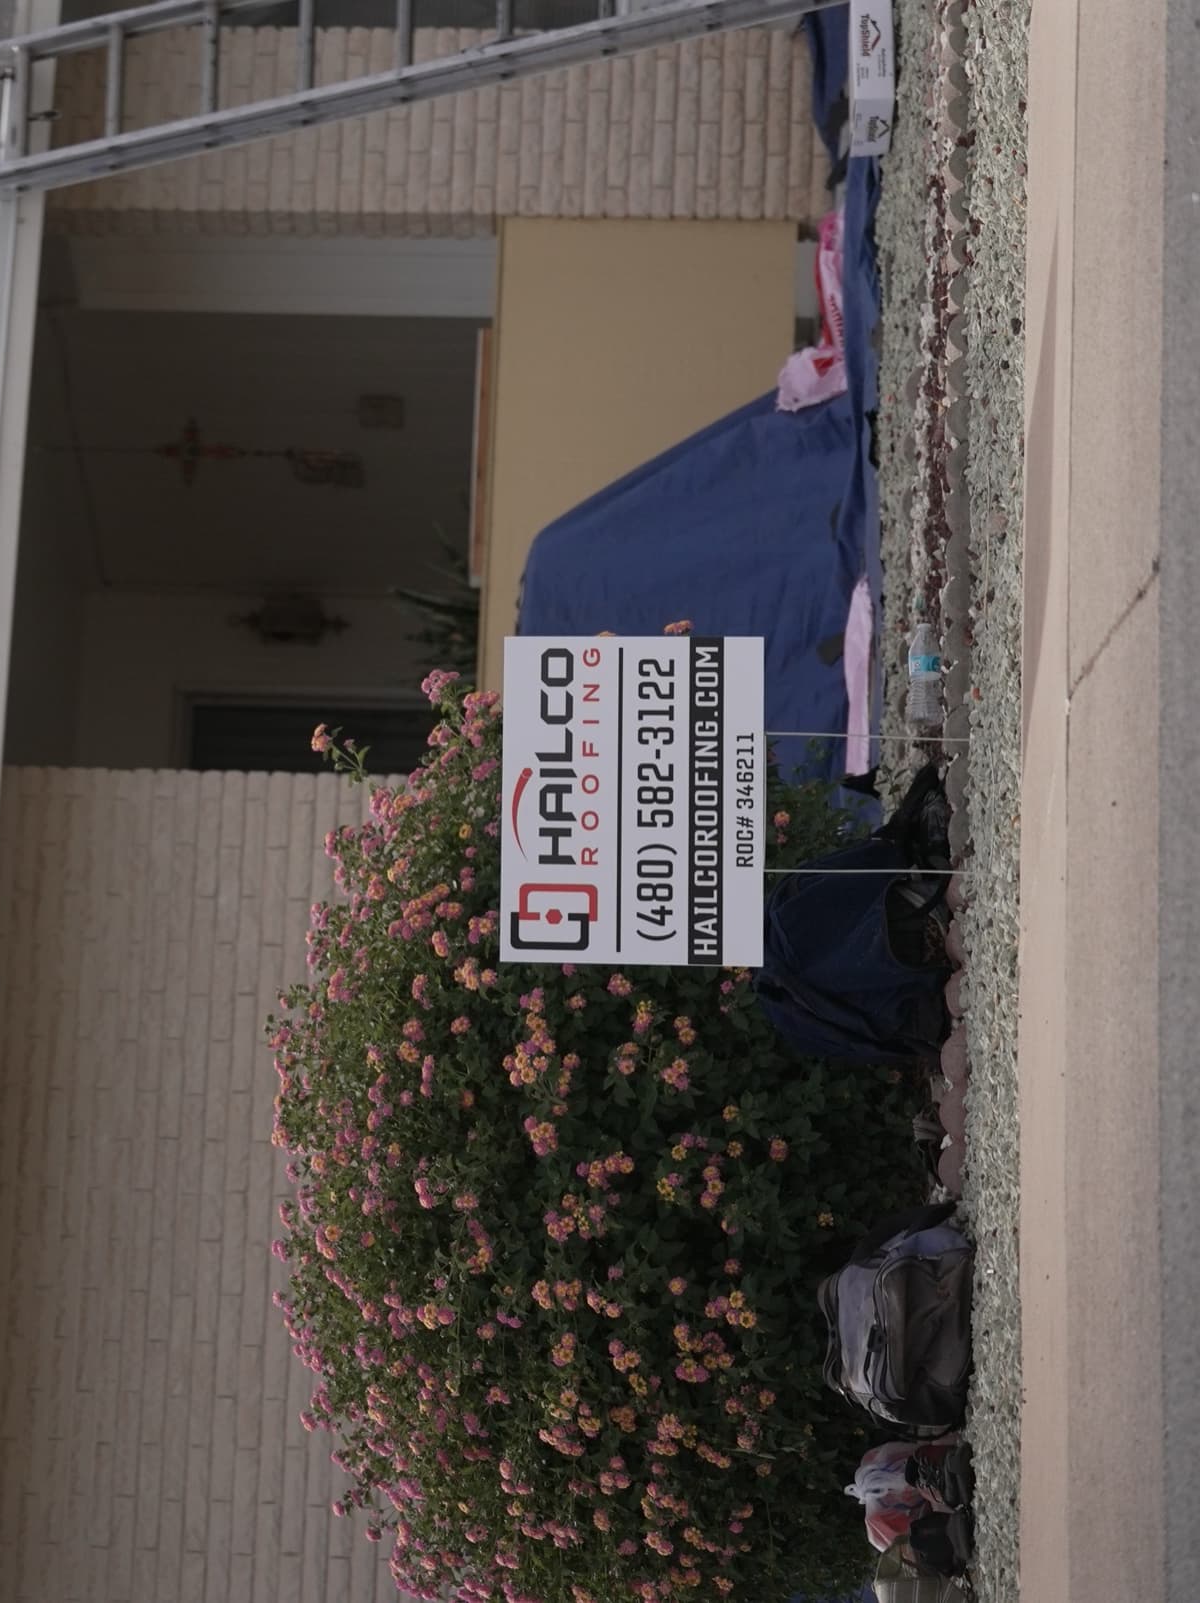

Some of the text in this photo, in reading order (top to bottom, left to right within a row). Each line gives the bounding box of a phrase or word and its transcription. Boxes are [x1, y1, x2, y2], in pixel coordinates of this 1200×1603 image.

[860, 13, 871, 57] TopShield
[534, 647, 578, 865] HAILCO
[580, 647, 601, 866] ROOFING
[636, 658, 678, 942] (480) 582-3122
[693, 645, 719, 956] HAILCOROOFING.COM
[736, 732, 755, 868] ROC# 346211
